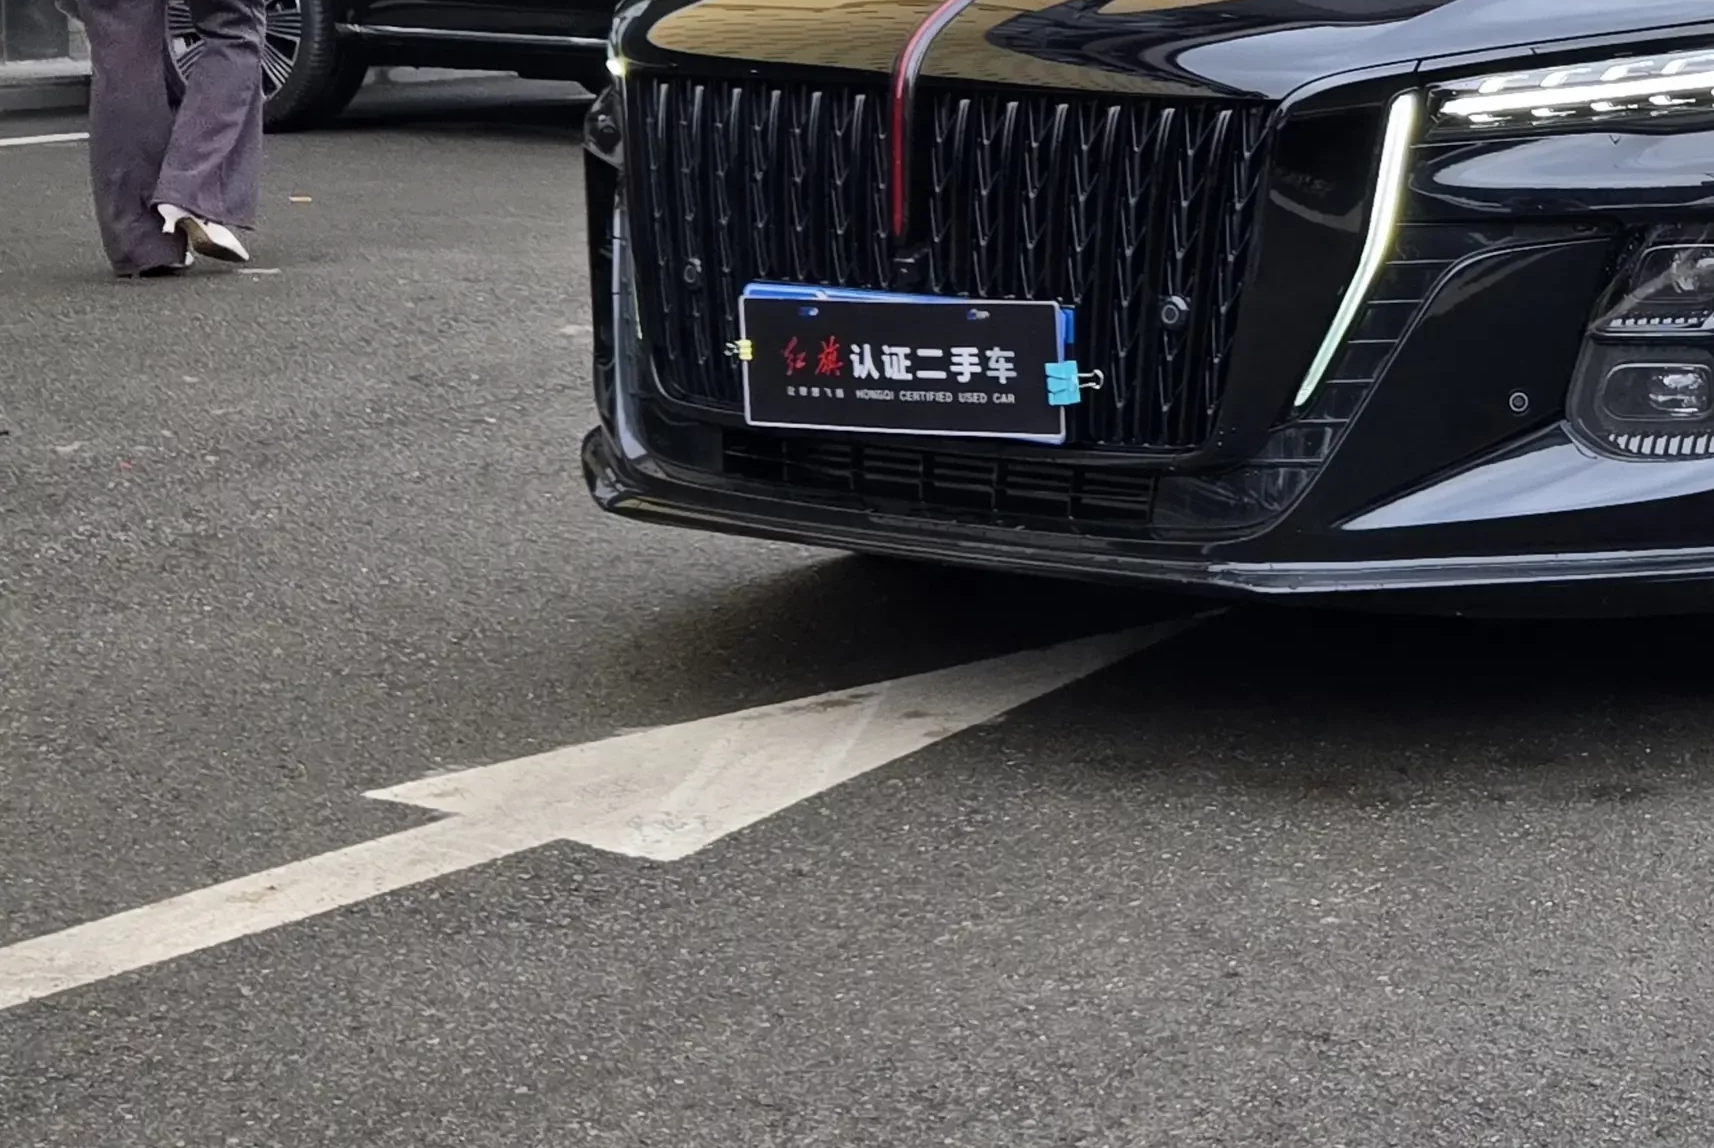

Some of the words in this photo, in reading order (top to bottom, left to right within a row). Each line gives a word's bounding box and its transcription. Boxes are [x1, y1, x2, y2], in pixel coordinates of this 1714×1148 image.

[850, 343, 1018, 384] 认证二手车
[899, 390, 954, 403] CERTIFIED
[958, 392, 988, 404] USED
[992, 393, 1016, 404] CAR
